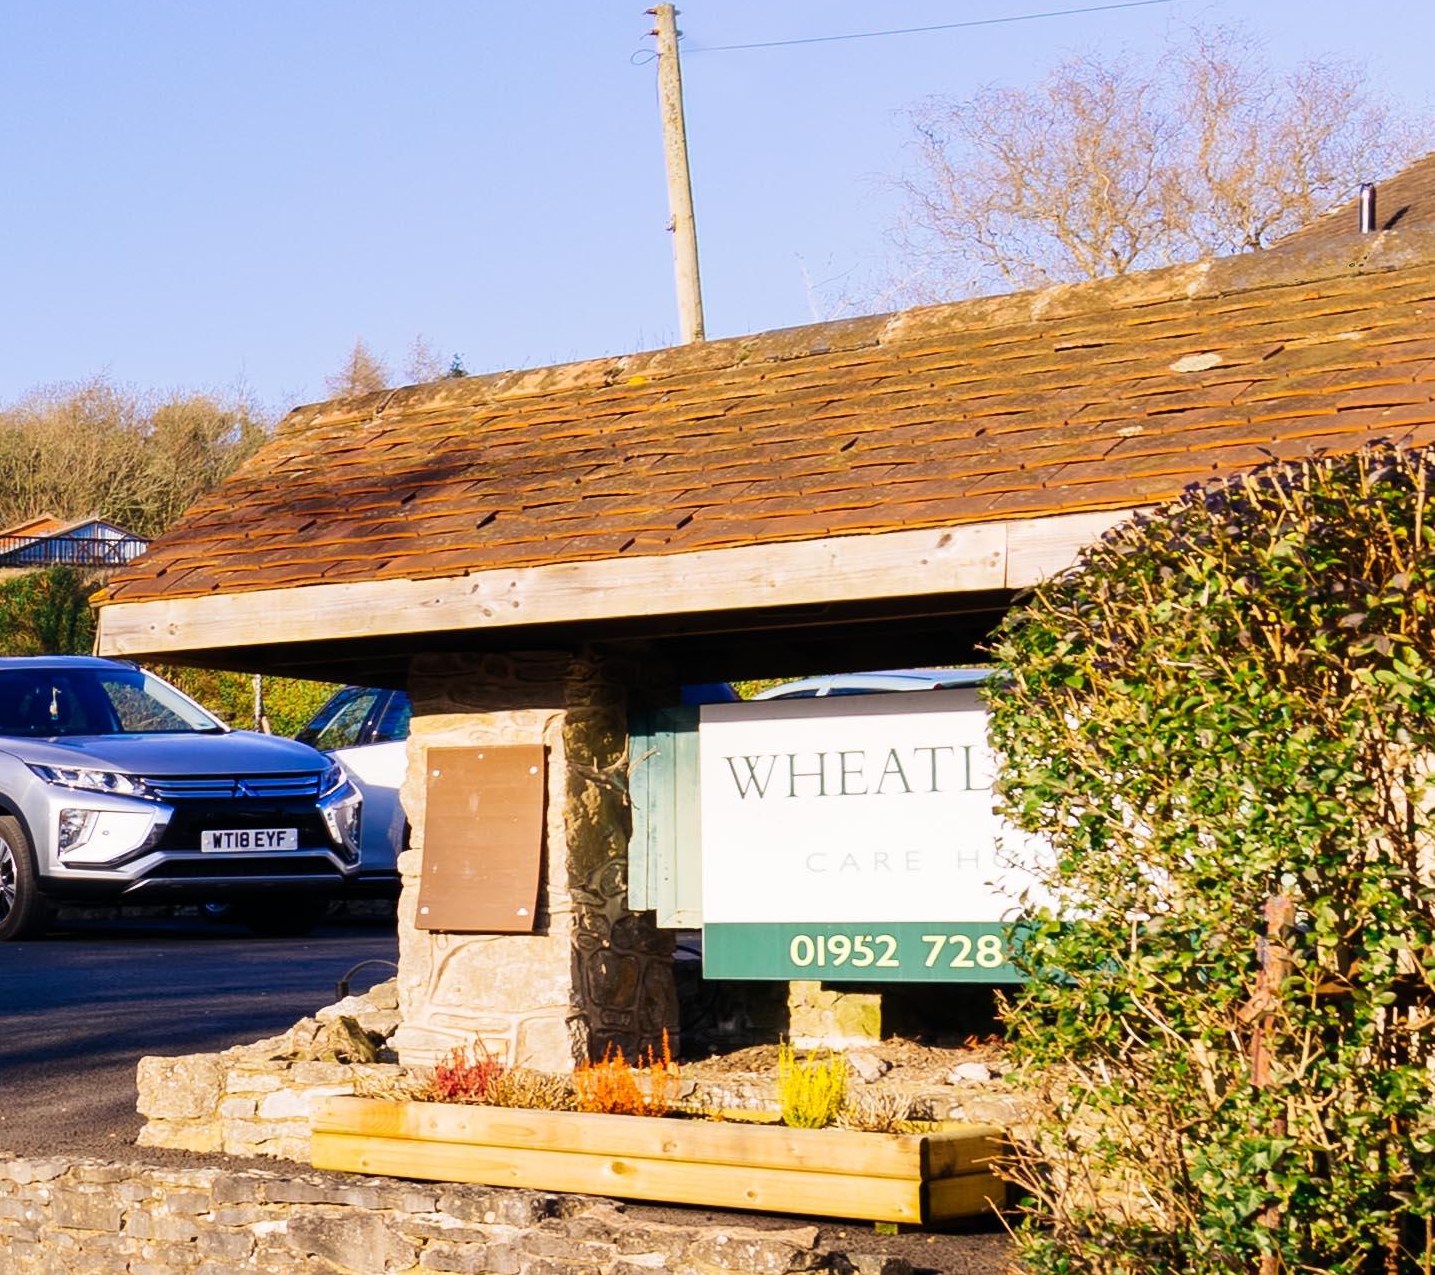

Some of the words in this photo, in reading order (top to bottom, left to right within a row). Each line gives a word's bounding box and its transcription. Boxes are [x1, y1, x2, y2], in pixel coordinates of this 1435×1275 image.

[721, 744, 992, 800] WHEATL
[212, 831, 250, 849] WT18
[254, 830, 287, 848] EYF
[805, 849, 922, 873] CARE
[789, 934, 900, 967] 01952
[921, 934, 1004, 968] 728
